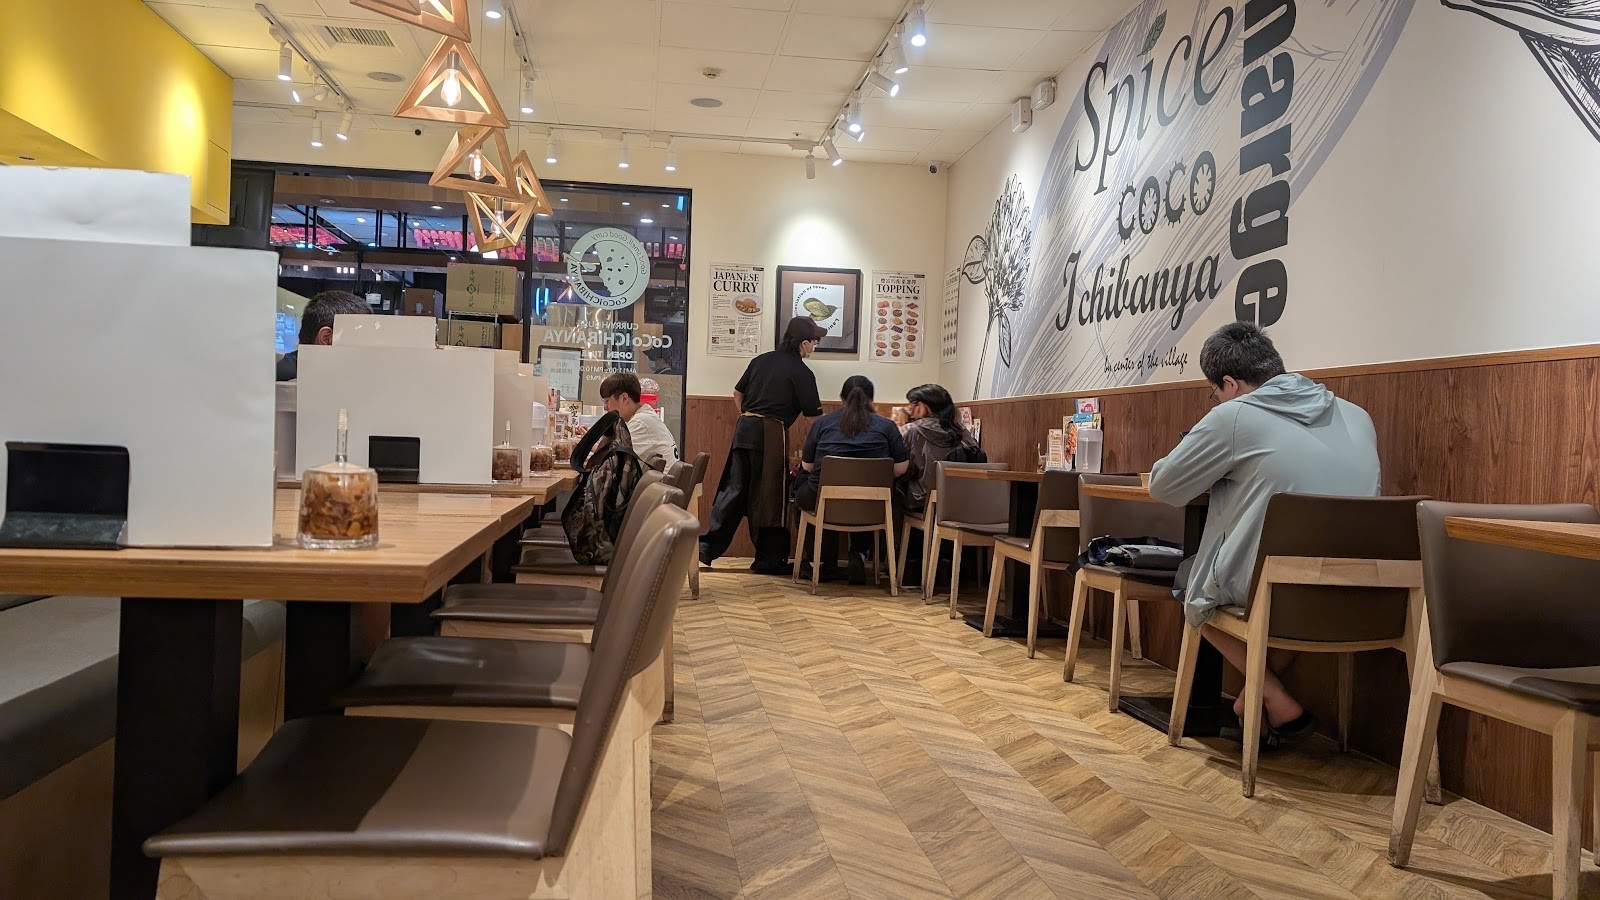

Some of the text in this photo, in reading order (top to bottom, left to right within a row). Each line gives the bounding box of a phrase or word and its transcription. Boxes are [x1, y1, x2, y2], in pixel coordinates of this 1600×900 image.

[1074, 6, 1234, 195] Spice
[713, 271, 760, 282] JAPANESE
[713, 280, 759, 293] CURRY
[876, 284, 920, 295] TOPPING
[1055, 250, 1222, 331] Ichibanya
